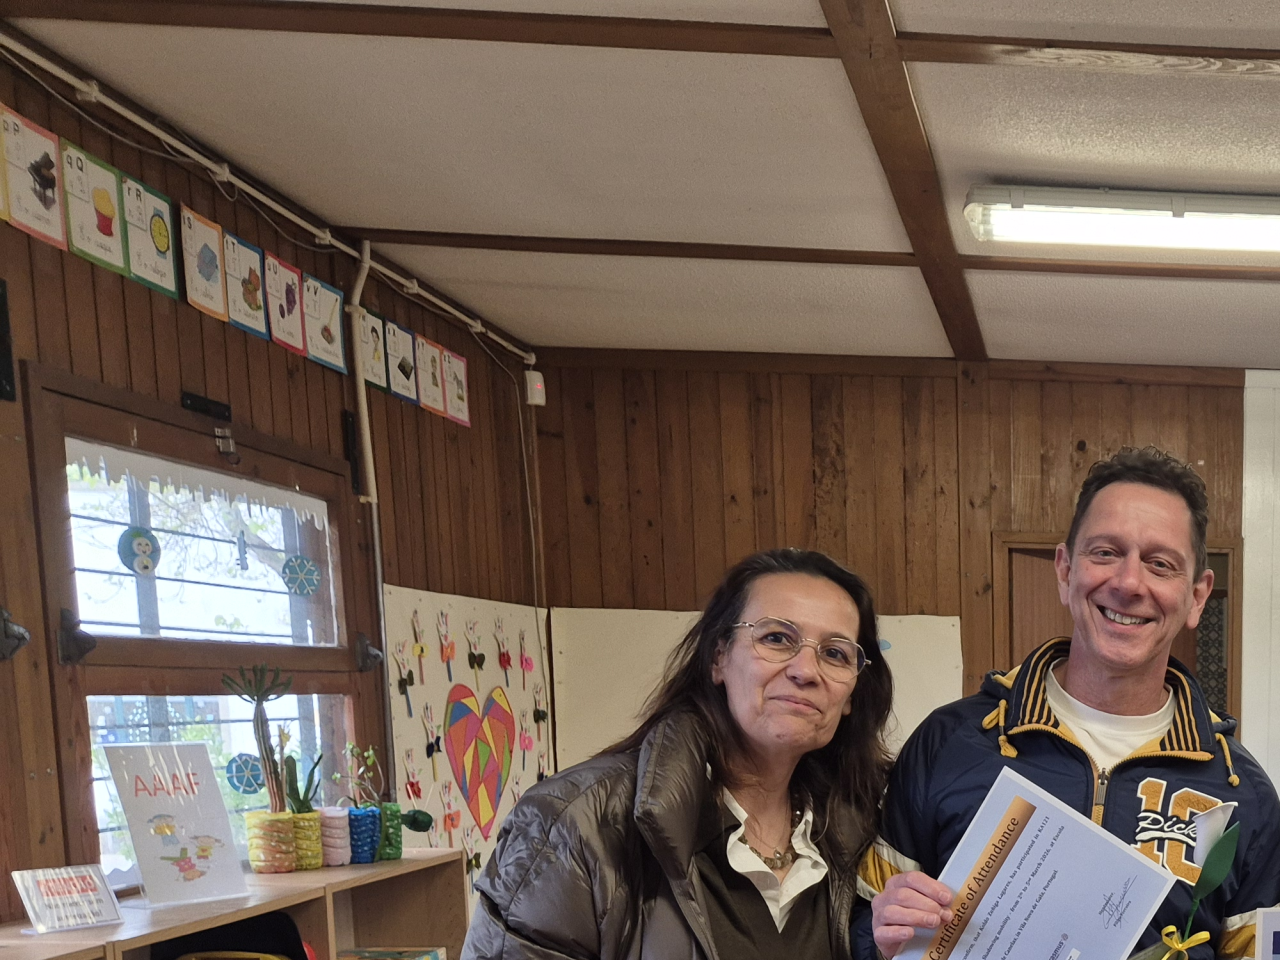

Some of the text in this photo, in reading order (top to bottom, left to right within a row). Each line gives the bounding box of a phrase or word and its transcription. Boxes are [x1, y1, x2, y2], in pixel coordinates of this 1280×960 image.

[76, 156, 84, 172] Q
[136, 188, 142, 202] R
[314, 286, 319, 296] V
[972, 817, 1020, 888] Attendance
[972, 931, 981, 942] that
[1009, 870, 1018, 879] has
[1016, 839, 1036, 870] participated
[1037, 816, 1050, 833] KA121
[965, 884, 980, 902] of
[982, 935, 1000, 960] Shadowing
[996, 915, 1011, 936] mobility
[1009, 899, 1020, 912] from
[1030, 862, 1042, 878] March
[1040, 848, 1052, 862] 2026,
[1052, 825, 1065, 842] Escola
[1018, 921, 1027, 931] Vila
[1023, 909, 1034, 922] Nova
